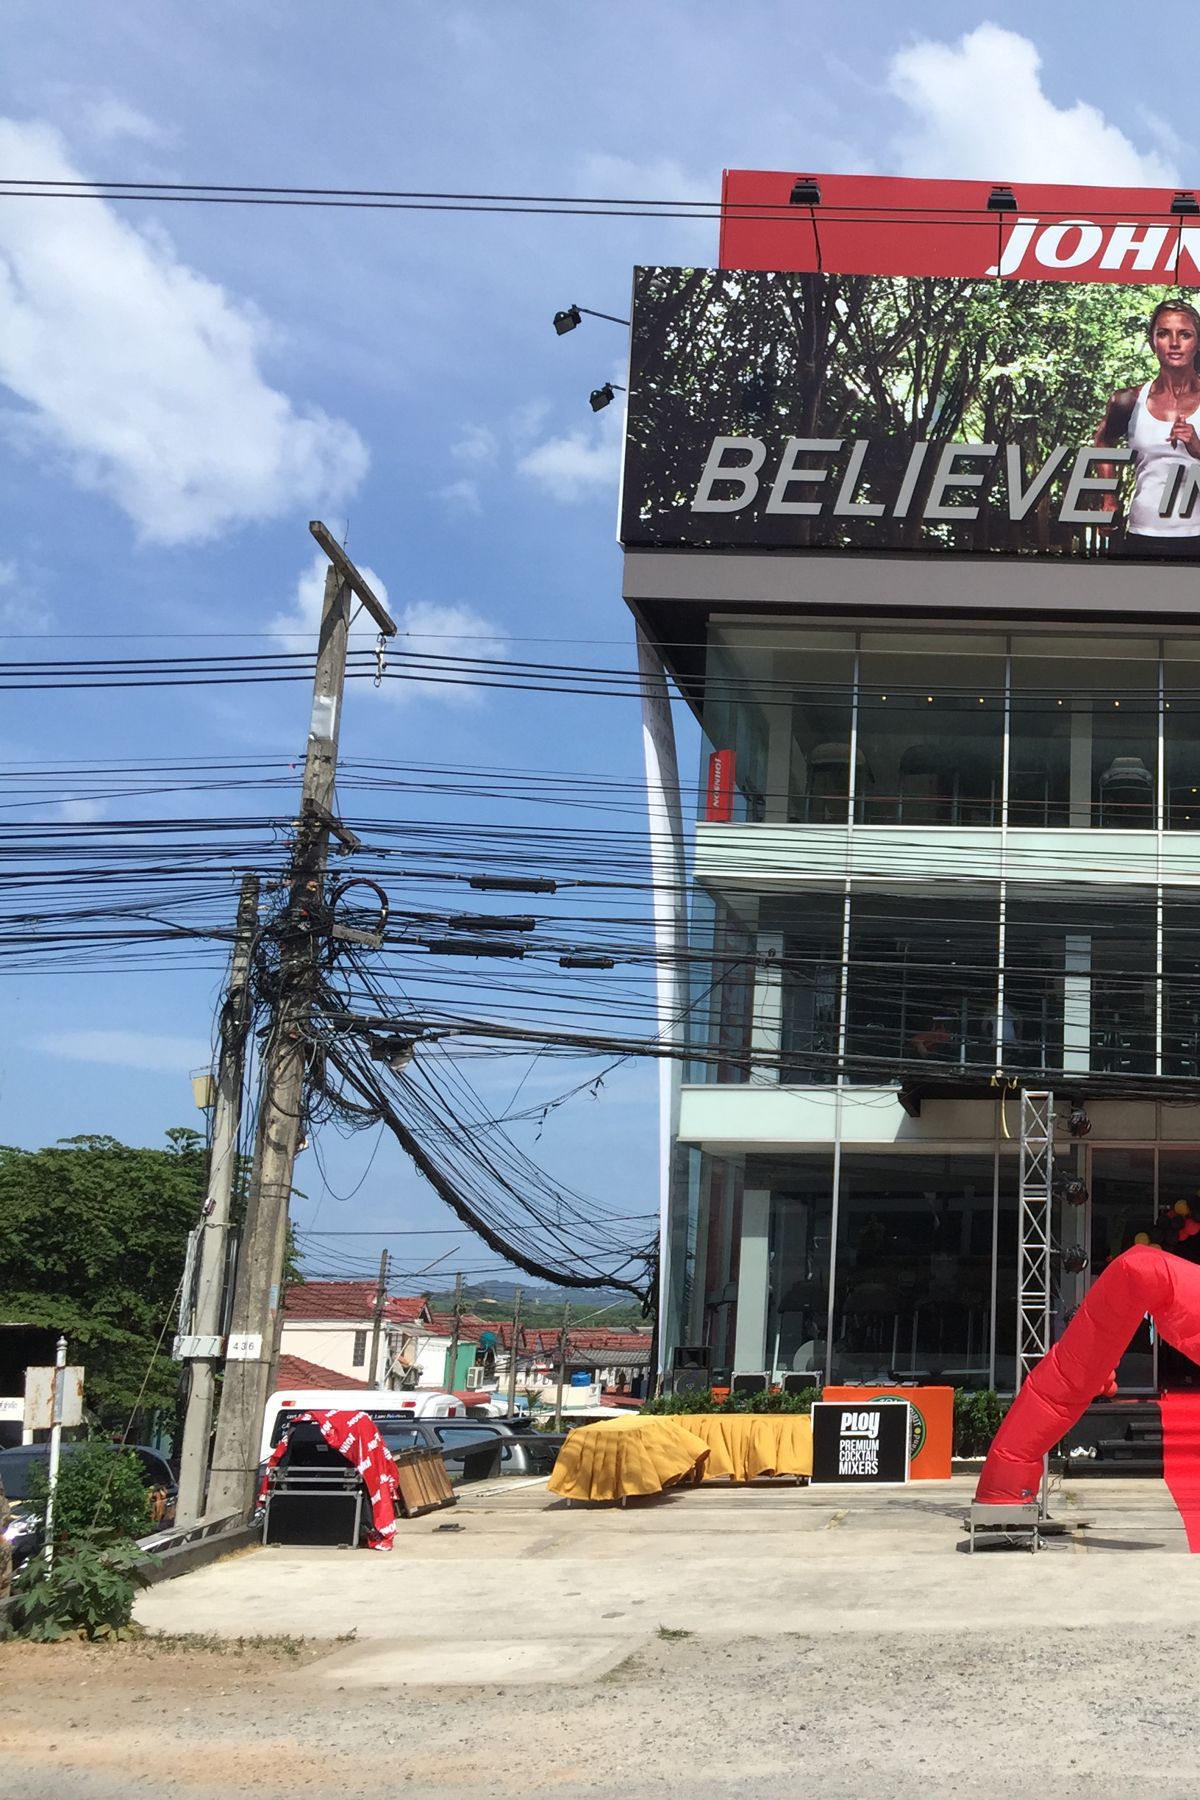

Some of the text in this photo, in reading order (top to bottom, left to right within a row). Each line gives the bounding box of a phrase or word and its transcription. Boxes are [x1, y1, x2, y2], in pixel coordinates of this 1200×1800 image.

[691, 436, 1138, 523] BELIEVE
[840, 1439, 879, 1451] PREMIUM
[839, 1450, 879, 1461] COCKTAIL
[839, 1461, 879, 1475] MIXERS
